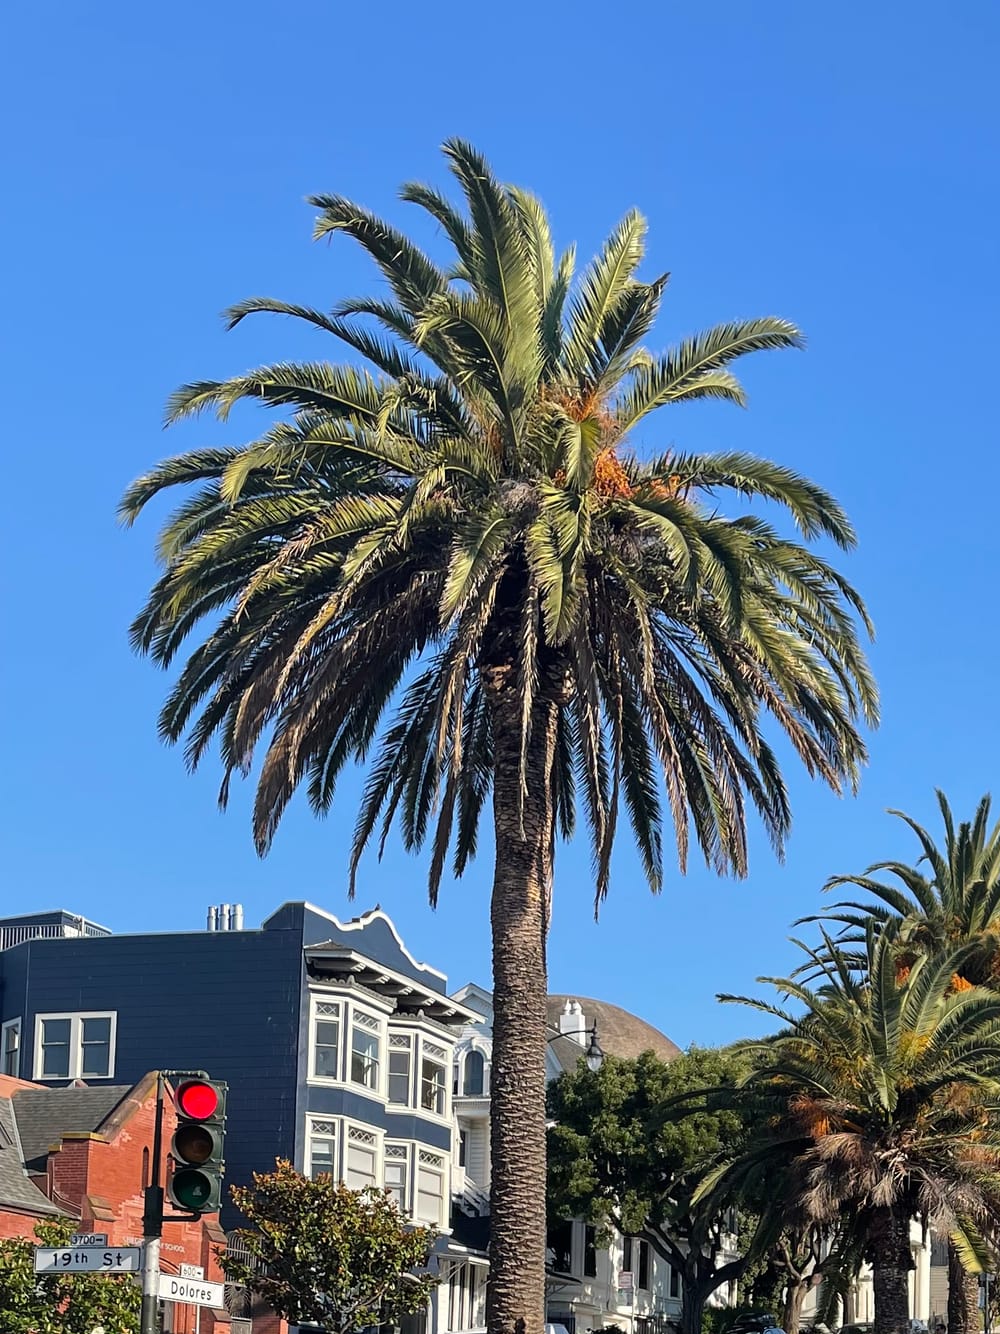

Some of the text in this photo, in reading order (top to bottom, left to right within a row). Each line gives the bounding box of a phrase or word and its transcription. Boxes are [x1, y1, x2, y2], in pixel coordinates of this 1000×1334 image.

[72, 1235, 95, 1245] 3700
[53, 1252, 122, 1266] 19th St
[183, 1267, 197, 1277] 600
[171, 1281, 212, 1301] Dolores
